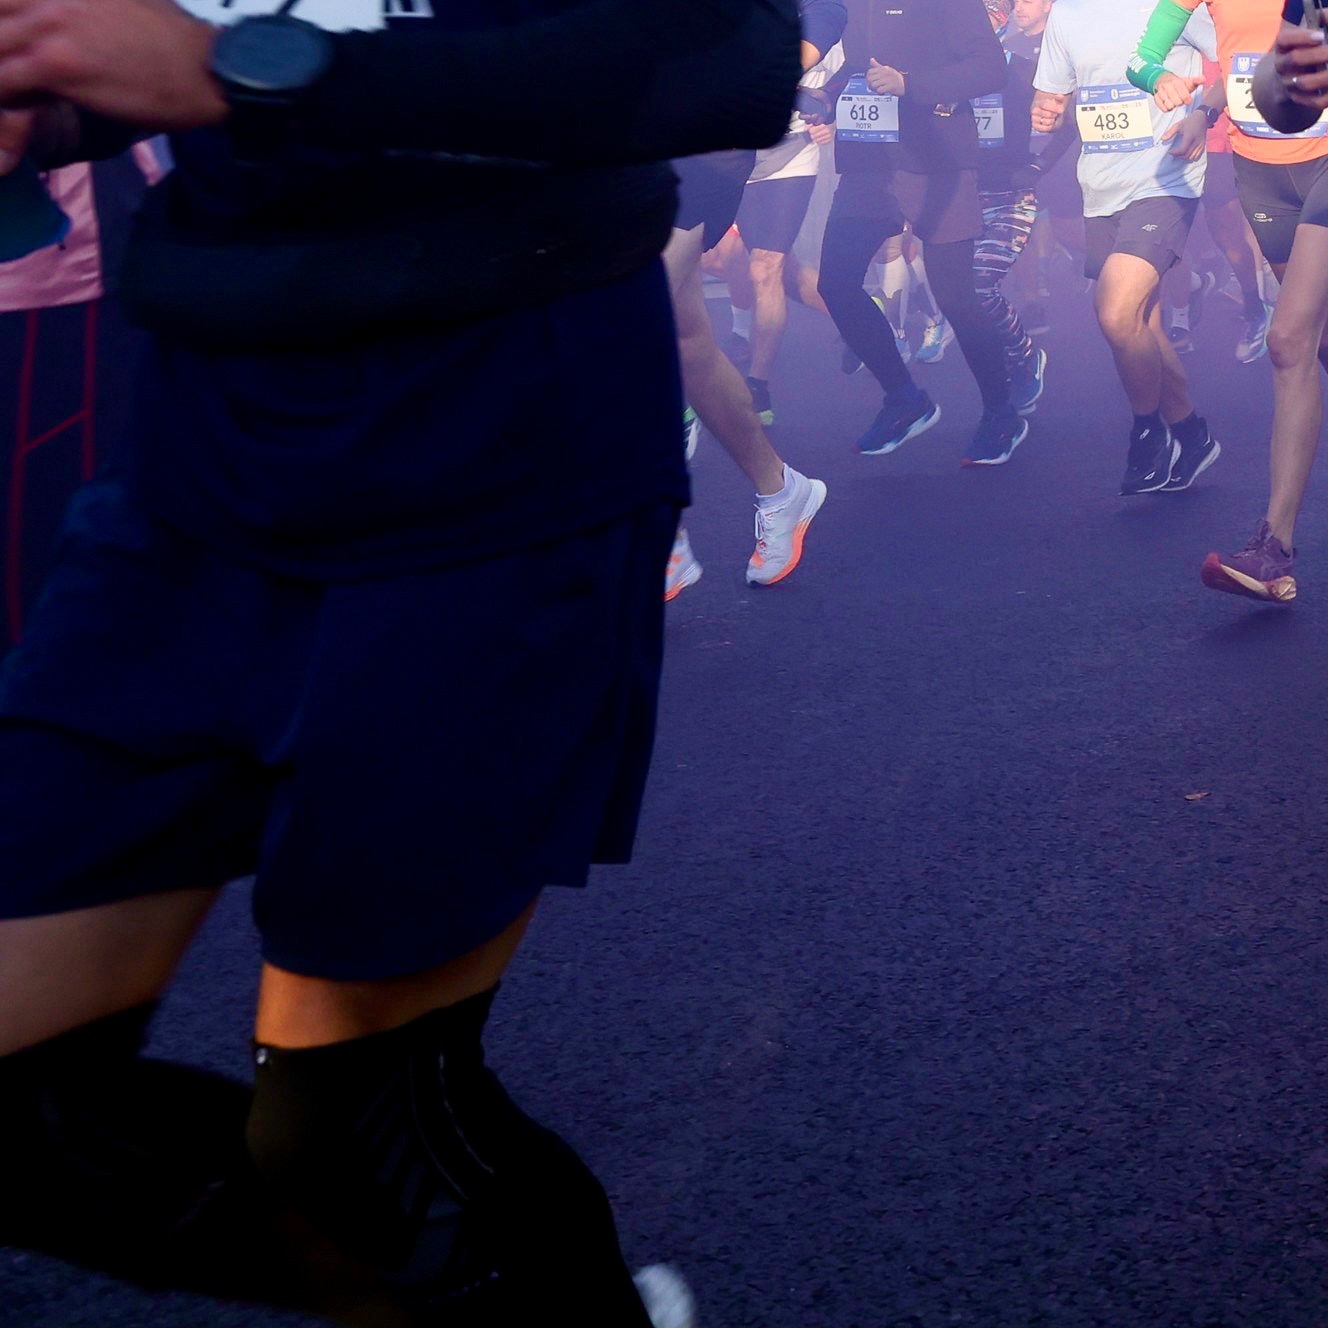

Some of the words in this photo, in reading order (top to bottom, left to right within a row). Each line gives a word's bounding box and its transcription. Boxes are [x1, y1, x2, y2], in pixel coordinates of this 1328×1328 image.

[850, 104, 879, 121] 618
[1094, 112, 1130, 131] 483
[1101, 132, 1126, 140] KAROL
